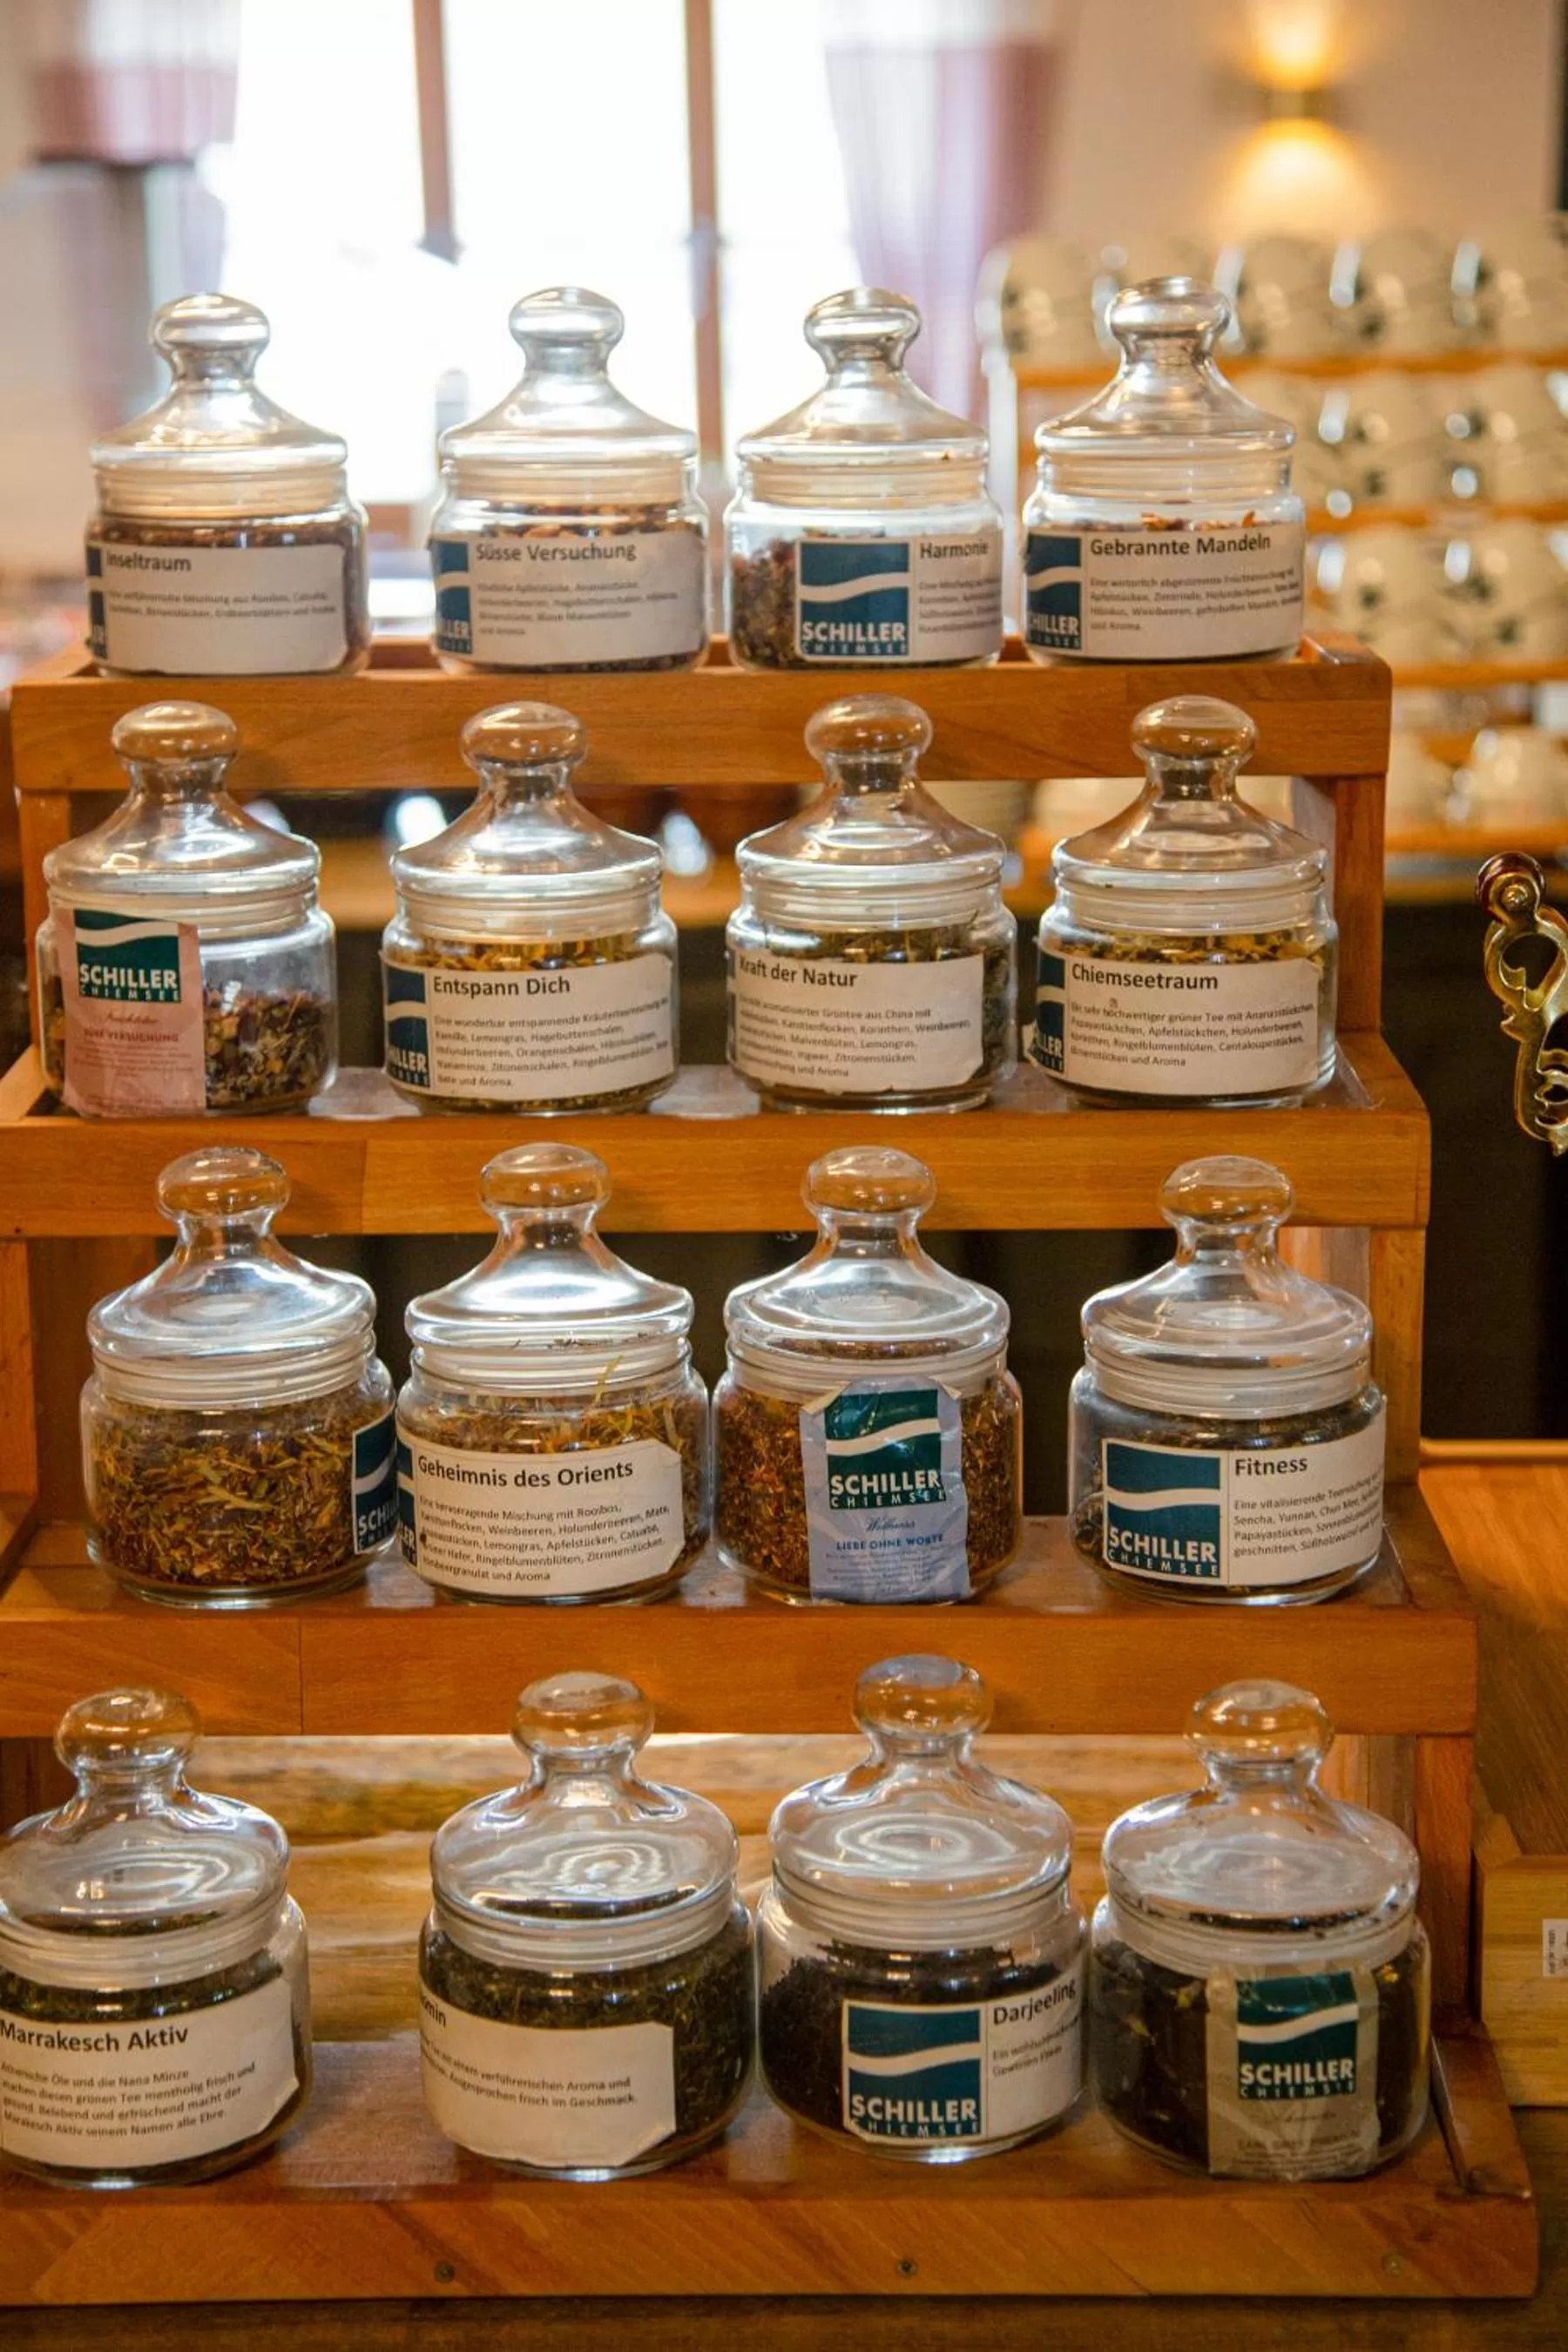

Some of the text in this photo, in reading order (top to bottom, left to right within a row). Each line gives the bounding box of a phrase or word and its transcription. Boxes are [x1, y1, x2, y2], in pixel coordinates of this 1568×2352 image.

[476, 542, 638, 562] Süsse Versuchung
[1091, 532, 1271, 556] Gebrannte Mandeln
[106, 551, 191, 571] Inseltraum
[801, 621, 906, 643] SCHILLER
[79, 963, 178, 990] SCHILLER
[739, 954, 858, 987] Kraft der Natur
[1071, 963, 1219, 990] Chiemseetraum
[80, 984, 180, 1001] CHIEMSEE
[434, 976, 571, 999] Entspann Dich
[1206, 1010, 1225, 1022] Tee
[418, 1455, 634, 1488] Geheimnis des Orients
[1234, 1456, 1308, 1477] Fitness
[830, 1469, 942, 1496] SCHILLER
[830, 1489, 947, 1508] CHIEMSEE
[1234, 1499, 1257, 1511] Eine
[502, 1510, 554, 1522] Mischung
[556, 1508, 574, 1521] mit
[1233, 1515, 1275, 1526] Sencha,
[484, 1538, 544, 1553] Lemongras,
[546, 1536, 618, 1553] Apfelstücken,
[836, 1540, 866, 1551] LIEBE
[868, 1538, 902, 1550] OHNE
[1109, 1525, 1218, 1563] SCHILLER
[1107, 1549, 1218, 1577] CHIEMSEE
[491, 1570, 512, 1581] und
[515, 1570, 551, 1582] Aroma
[993, 1979, 1077, 2026] Darjeeling
[0, 2018, 188, 2052] Marrakesch Aktiv
[72, 2076, 94, 2087] und
[97, 2075, 116, 2087] die
[152, 2069, 189, 2083] Minze
[1240, 2058, 1355, 2085] SCHILLER
[76, 2093, 117, 2106] grünen
[121, 2092, 142, 2105] Tee
[145, 2081, 204, 2102] mentholig
[237, 2060, 255, 2079] und
[566, 2078, 605, 2092] Aroma
[608, 2075, 632, 2091] und
[91, 2108, 115, 2120] und
[118, 2100, 184, 2121] erfrischend
[187, 2092, 221, 2112] macht
[224, 2085, 242, 2101] der
[518, 2092, 549, 2106] frisch
[851, 2093, 977, 2123] SCHILLER
[85, 2127, 128, 2139] seinem
[131, 2124, 174, 2136] Namen
[176, 2117, 198, 2131] alle
